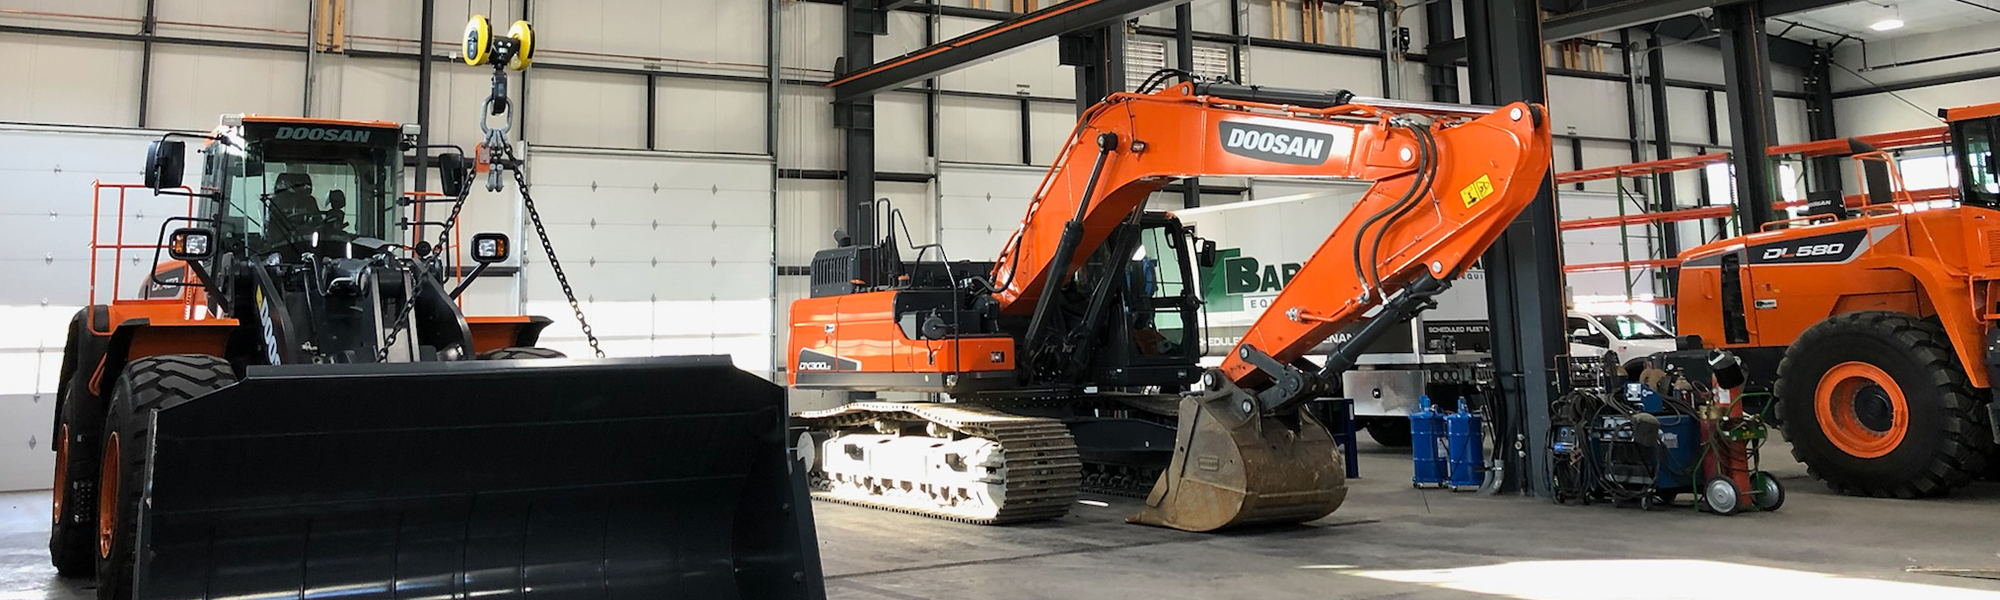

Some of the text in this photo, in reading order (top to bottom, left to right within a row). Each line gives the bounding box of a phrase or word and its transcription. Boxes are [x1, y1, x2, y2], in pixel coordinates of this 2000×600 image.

[275, 127, 370, 142] DOOSAN
[1227, 128, 1324, 159] DOOSAN
[1763, 243, 1844, 259] DL580
[1226, 257, 1303, 294] BAR
